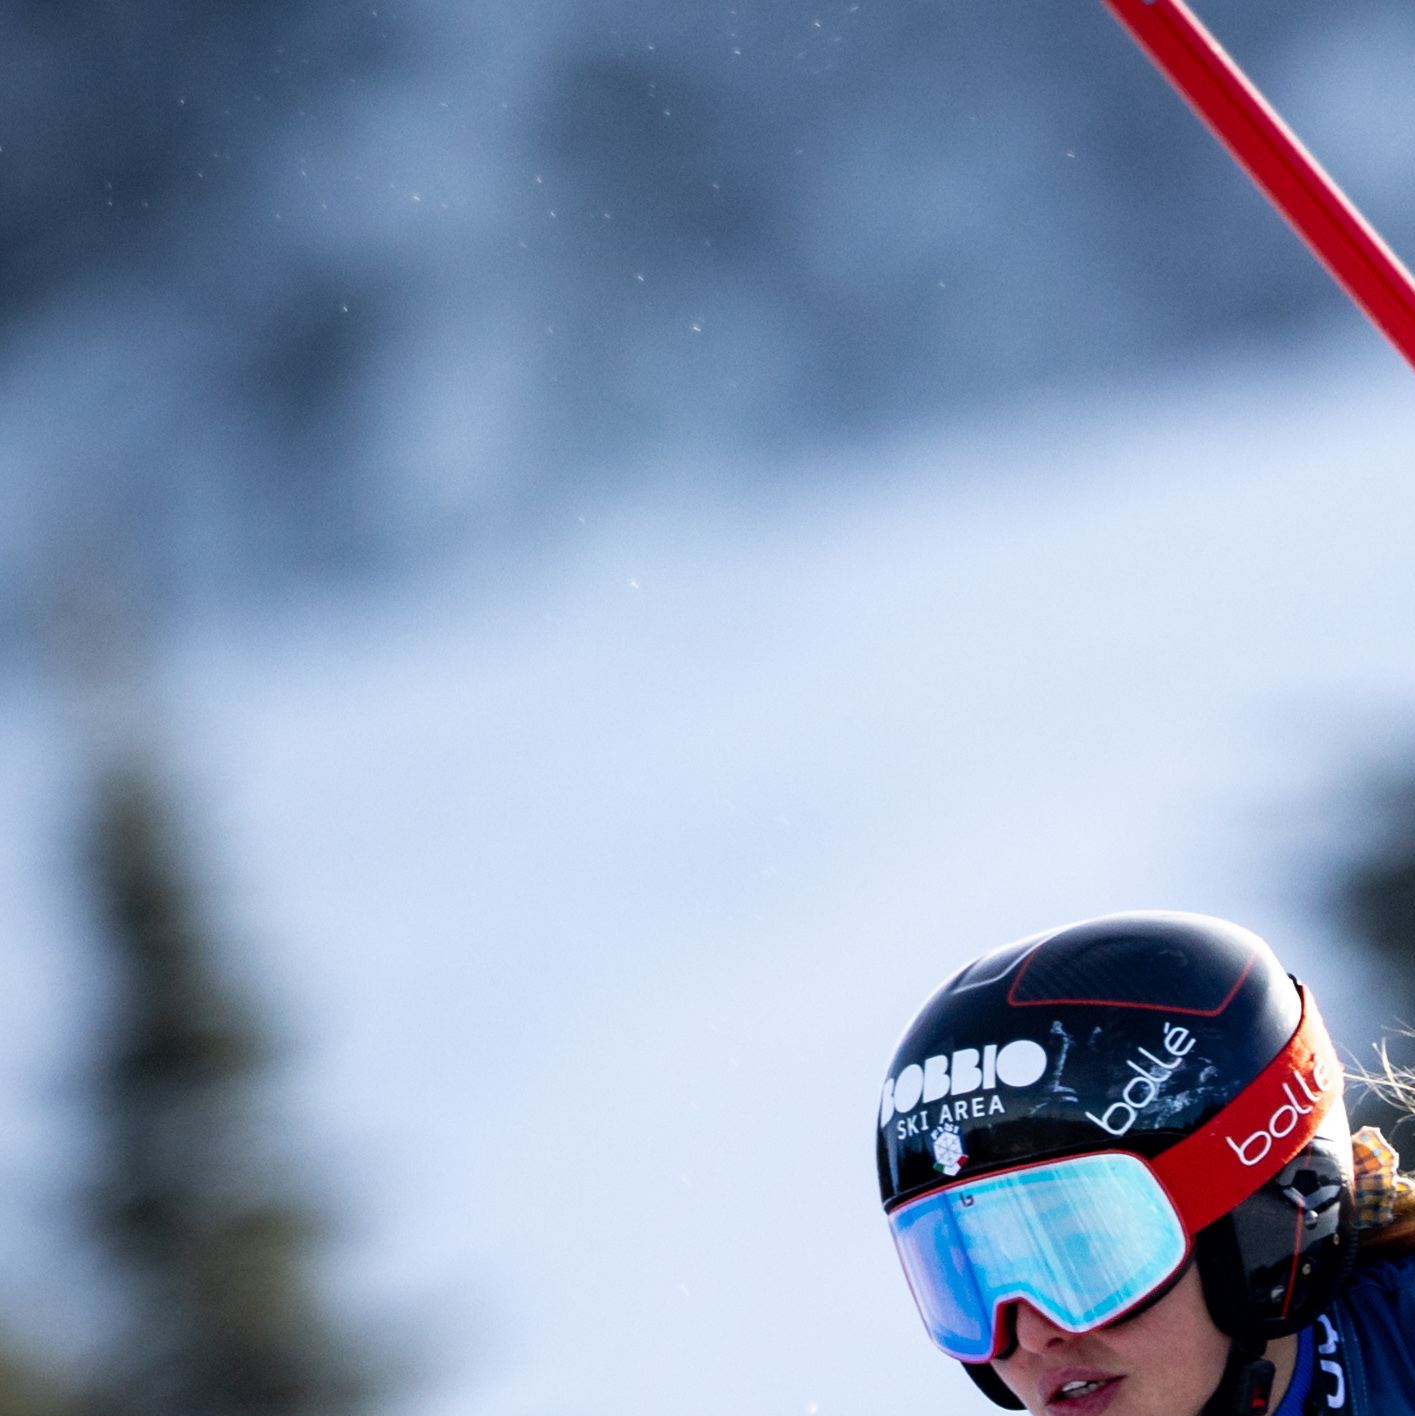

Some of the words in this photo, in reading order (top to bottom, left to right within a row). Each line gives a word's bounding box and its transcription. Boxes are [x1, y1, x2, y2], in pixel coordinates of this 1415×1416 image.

[897, 1110, 930, 1141] SKI
[939, 1094, 1006, 1124] AREA
[1085, 1022, 1197, 1137] bollé
[1226, 1050, 1342, 1167] bollé
